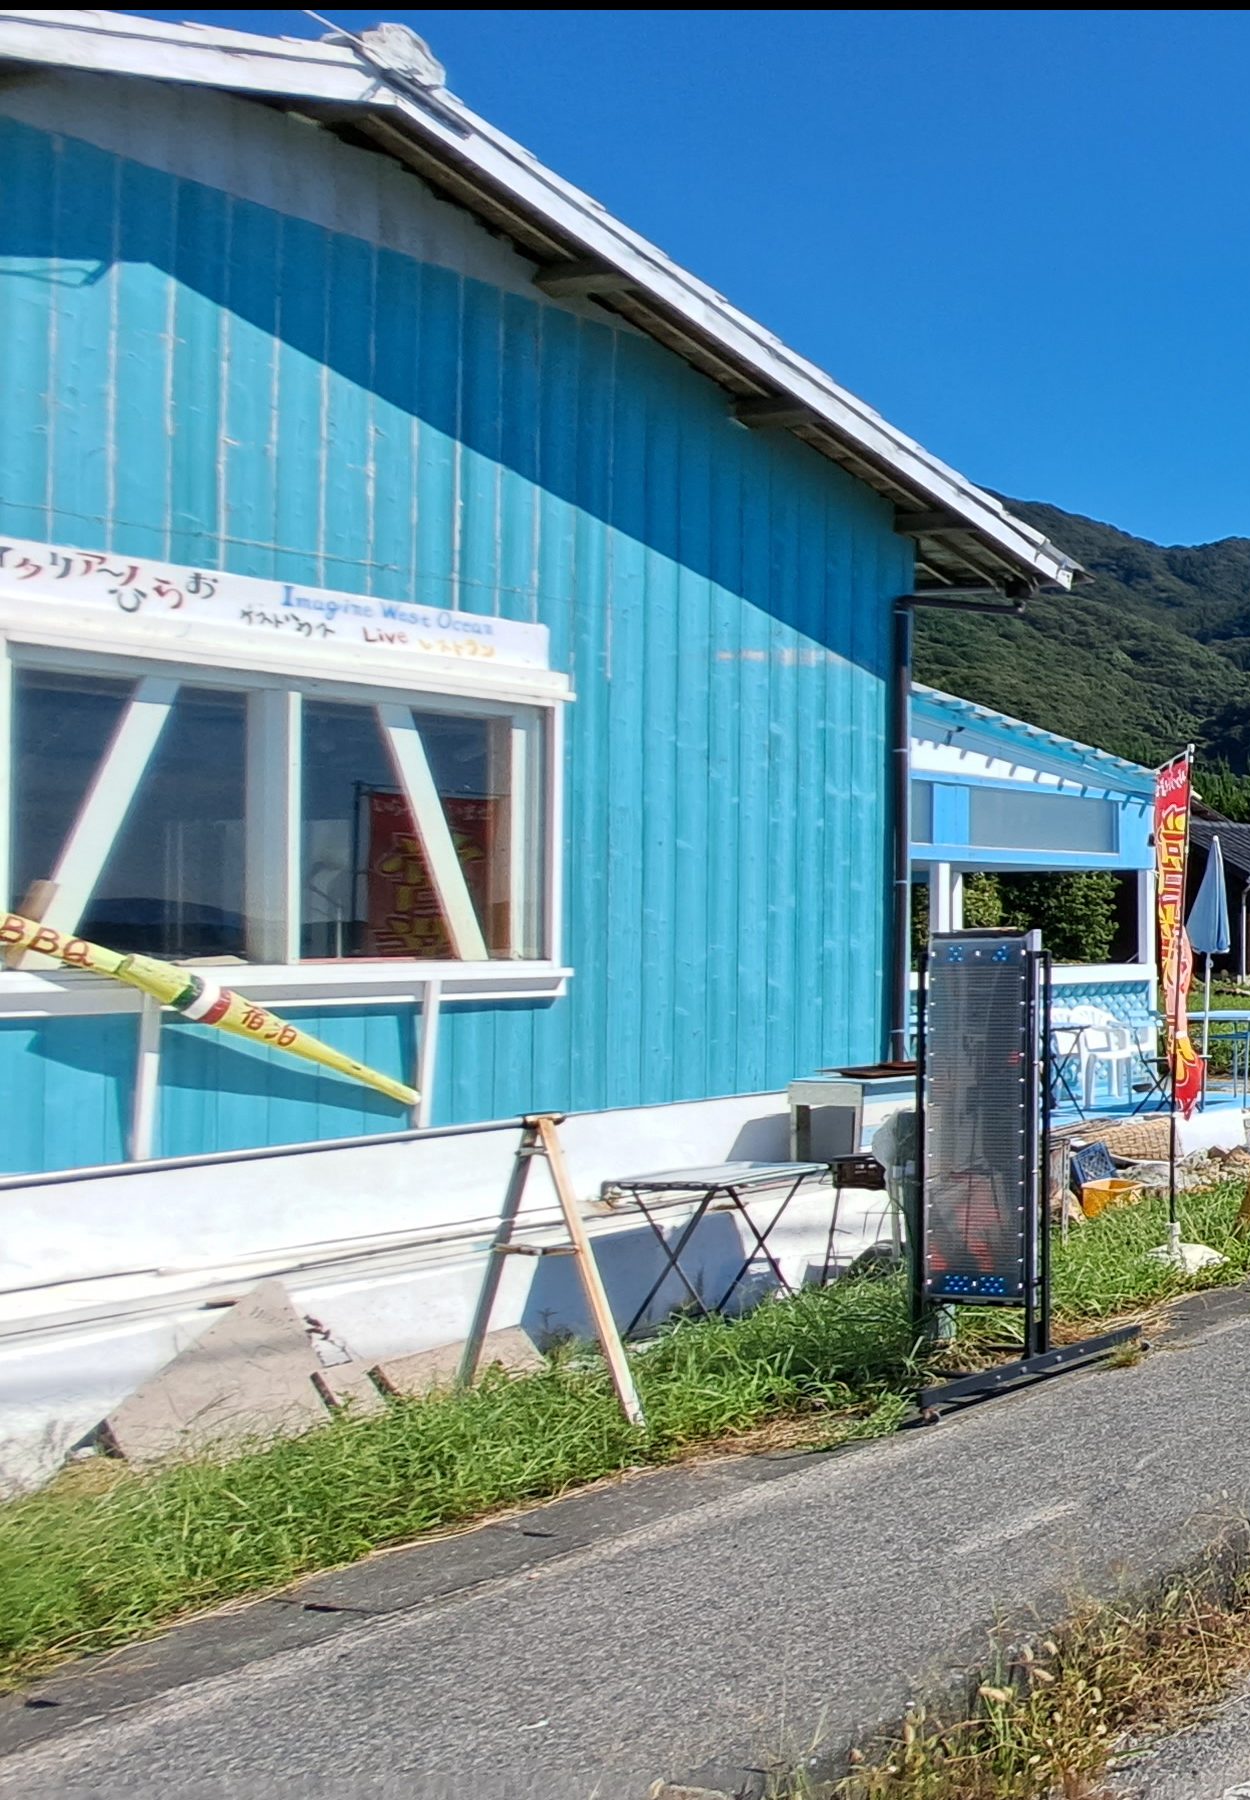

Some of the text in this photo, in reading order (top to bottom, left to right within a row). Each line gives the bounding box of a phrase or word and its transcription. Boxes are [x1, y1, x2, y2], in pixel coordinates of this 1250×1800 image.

[108, 572, 219, 613] ひらお
[281, 585, 494, 635] Imagine West Ocean
[362, 626, 408, 644] Live
[0, 915, 94, 967] BBQ
